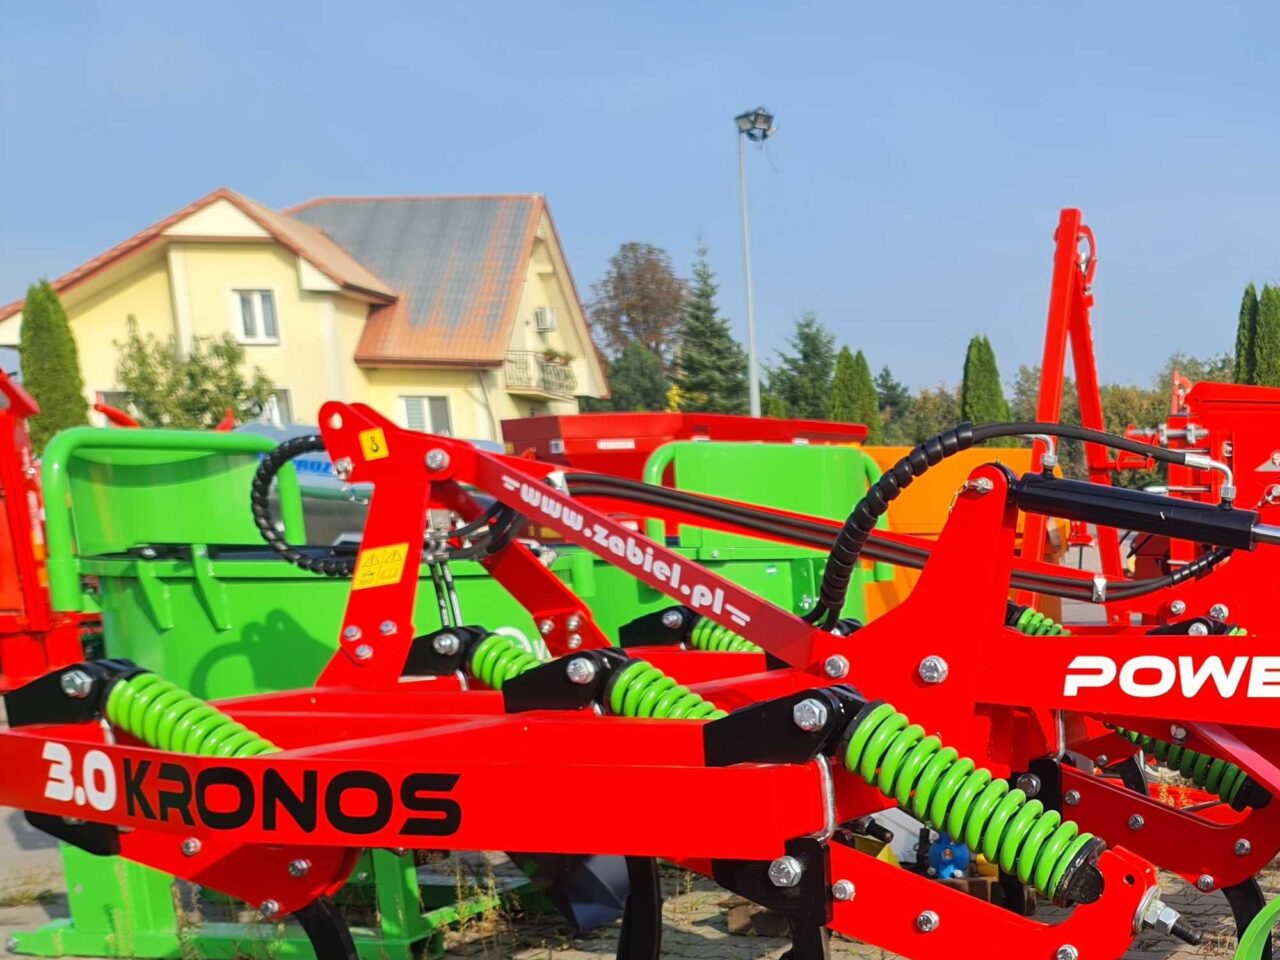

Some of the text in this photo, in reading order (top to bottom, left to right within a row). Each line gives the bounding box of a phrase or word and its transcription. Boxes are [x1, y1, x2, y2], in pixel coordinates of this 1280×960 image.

[520, 483, 724, 615] www.zabiel.pl
[42, 741, 462, 836] 3.0 KRONOS
